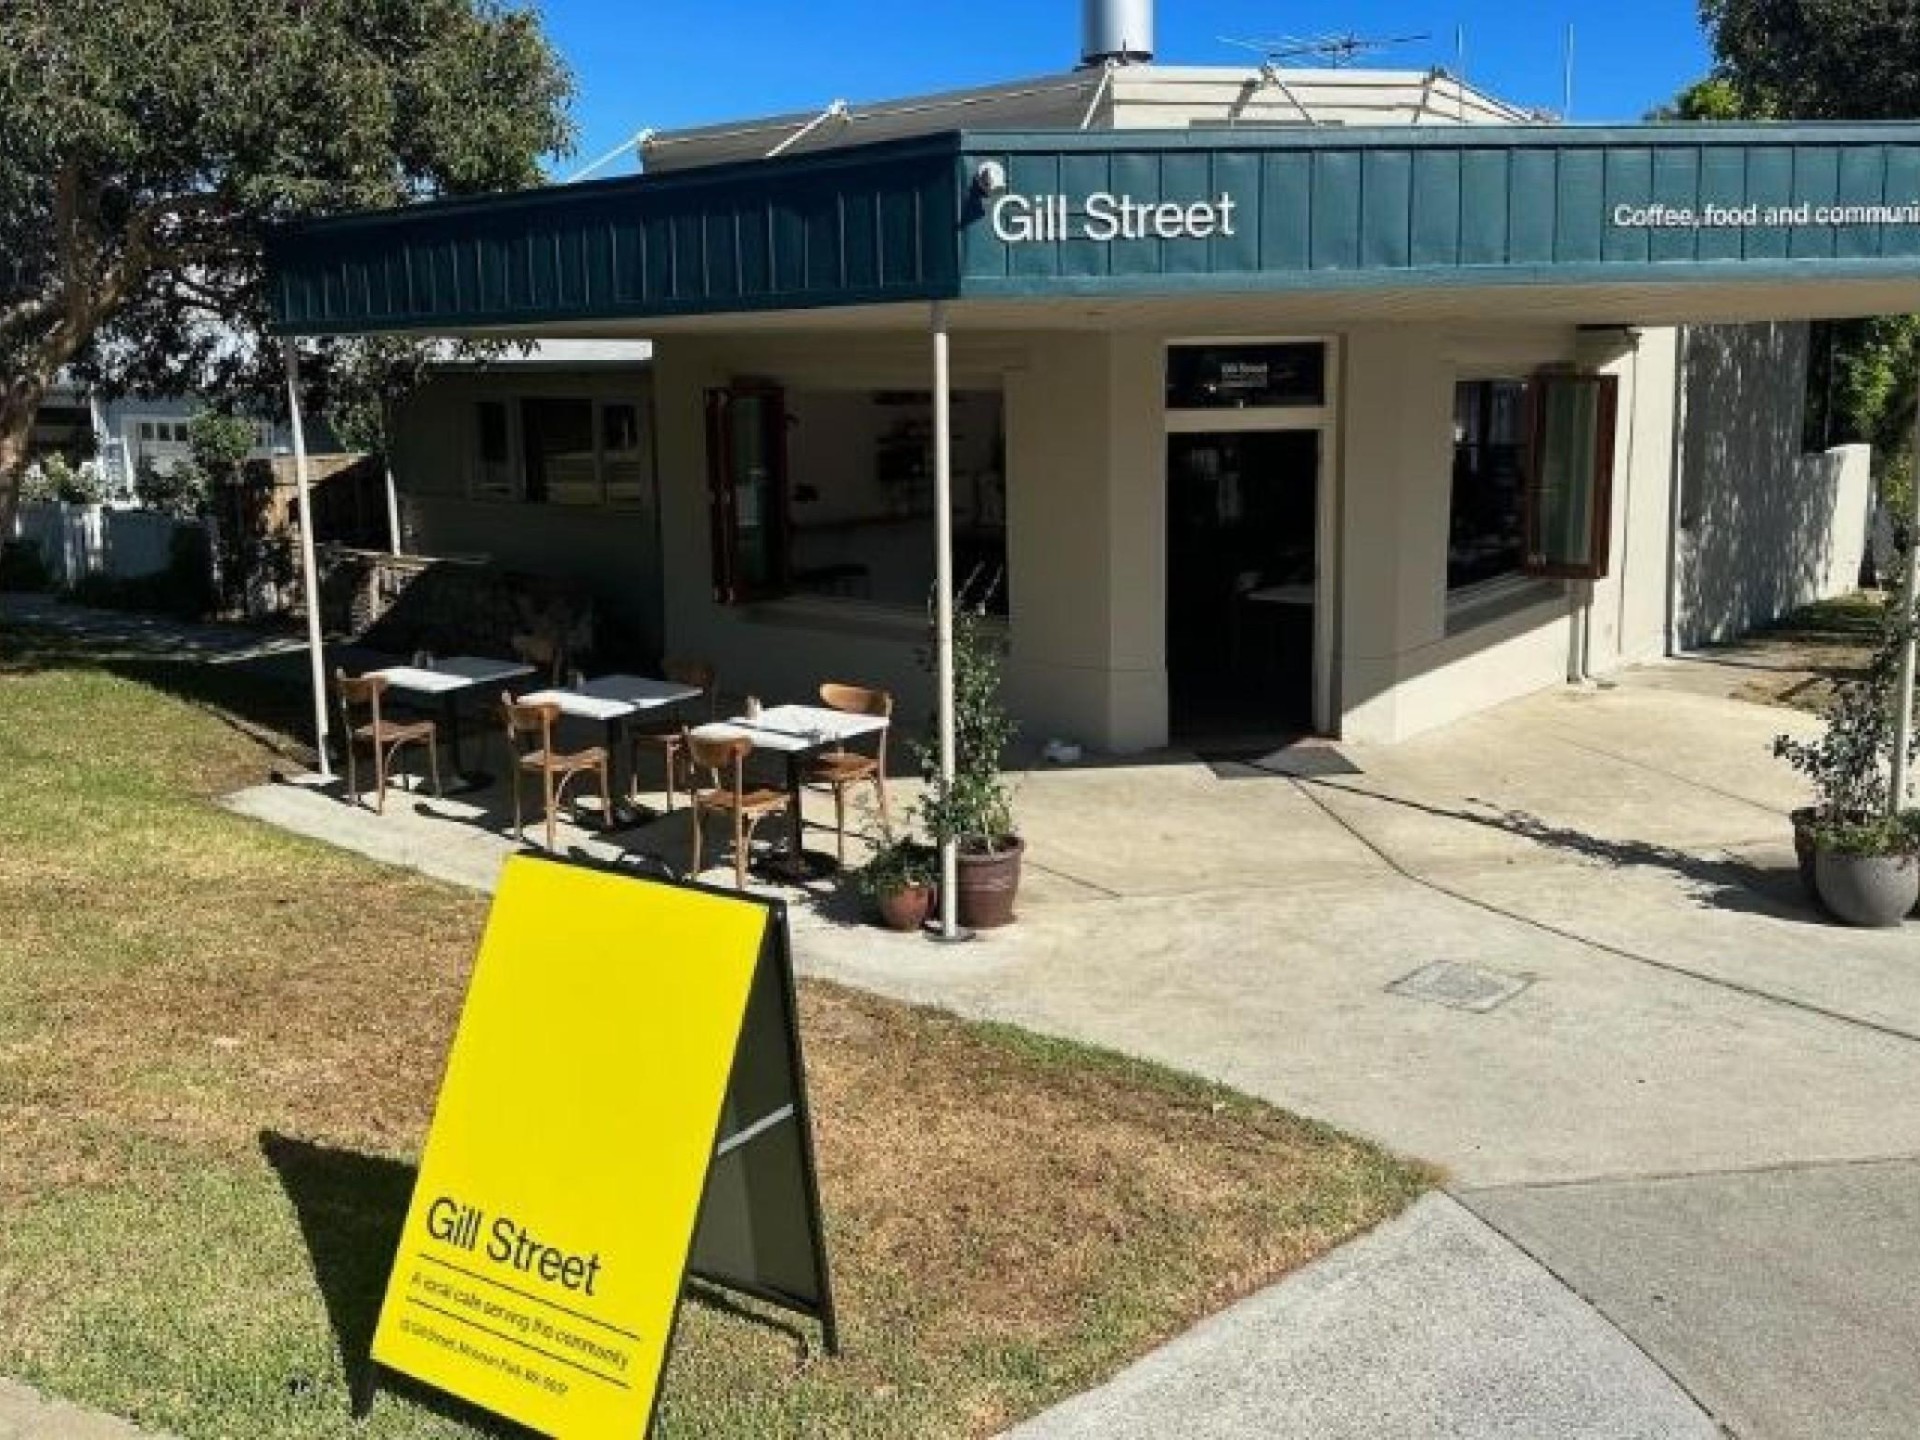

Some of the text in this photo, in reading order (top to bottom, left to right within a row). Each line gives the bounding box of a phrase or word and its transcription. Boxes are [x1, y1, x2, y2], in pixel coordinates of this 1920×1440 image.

[993, 191, 1236, 242] Gill Street
[1614, 200, 1920, 229] Coffee, food and communi
[426, 1196, 601, 1297] Gill Street
[483, 1302, 530, 1332] serving
[555, 1330, 629, 1371] community
